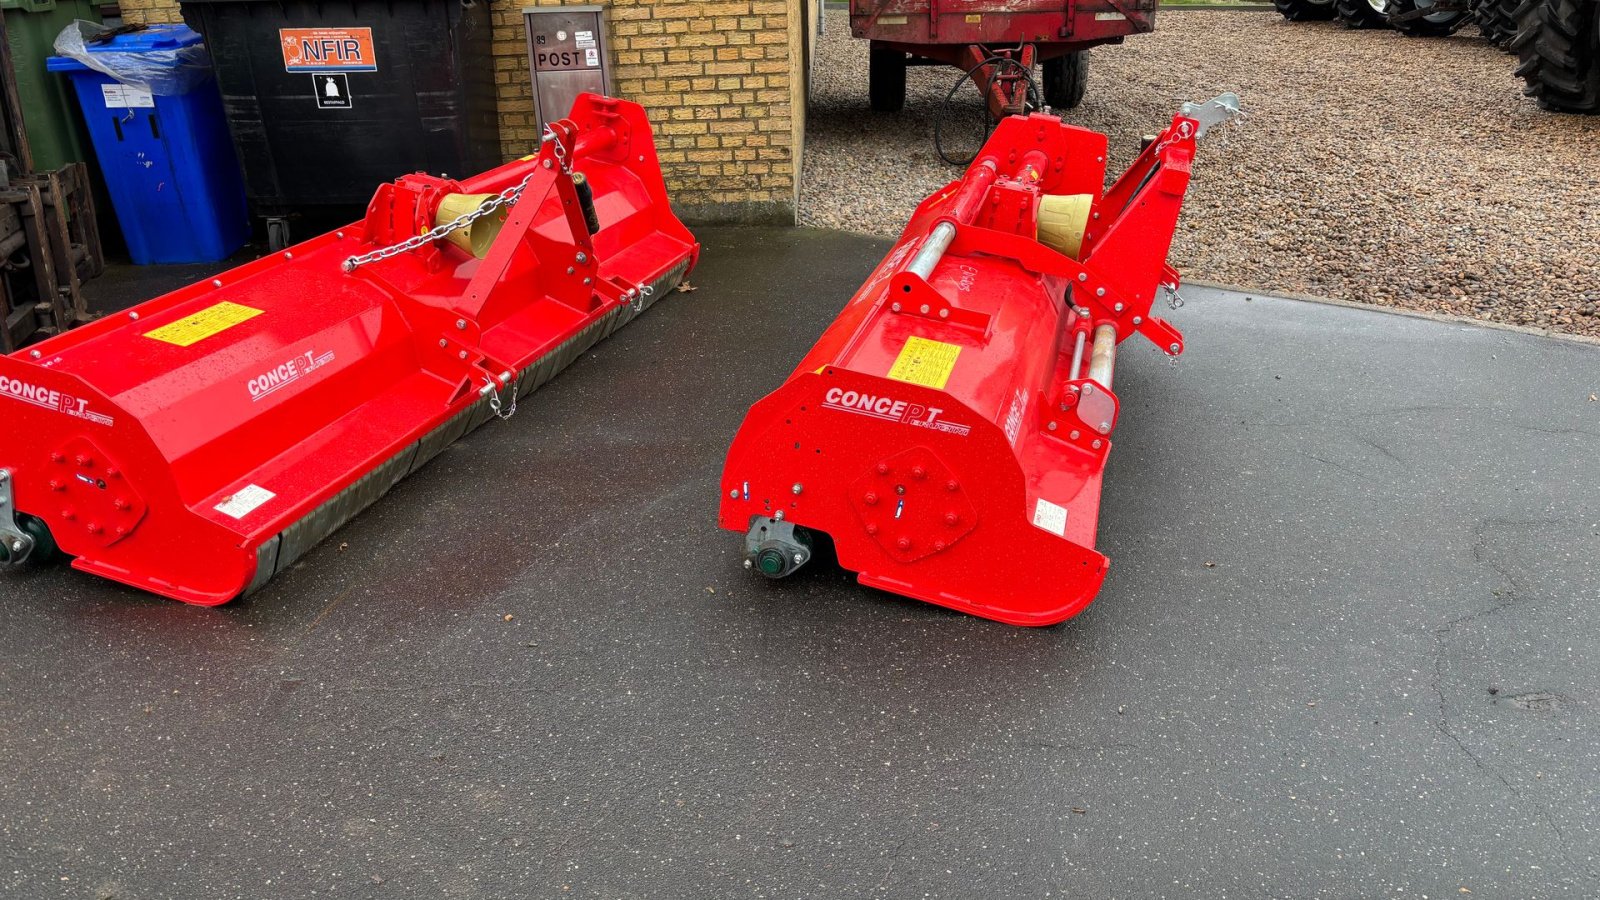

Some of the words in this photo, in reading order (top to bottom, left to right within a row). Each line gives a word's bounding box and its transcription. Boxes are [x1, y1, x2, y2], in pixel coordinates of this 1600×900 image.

[302, 38, 362, 61] NFIR
[538, 52, 580, 66] POST
[247, 350, 313, 396] CONCEPT
[0, 375, 89, 413] CONCEPT
[825, 388, 943, 424] CONCEPT
